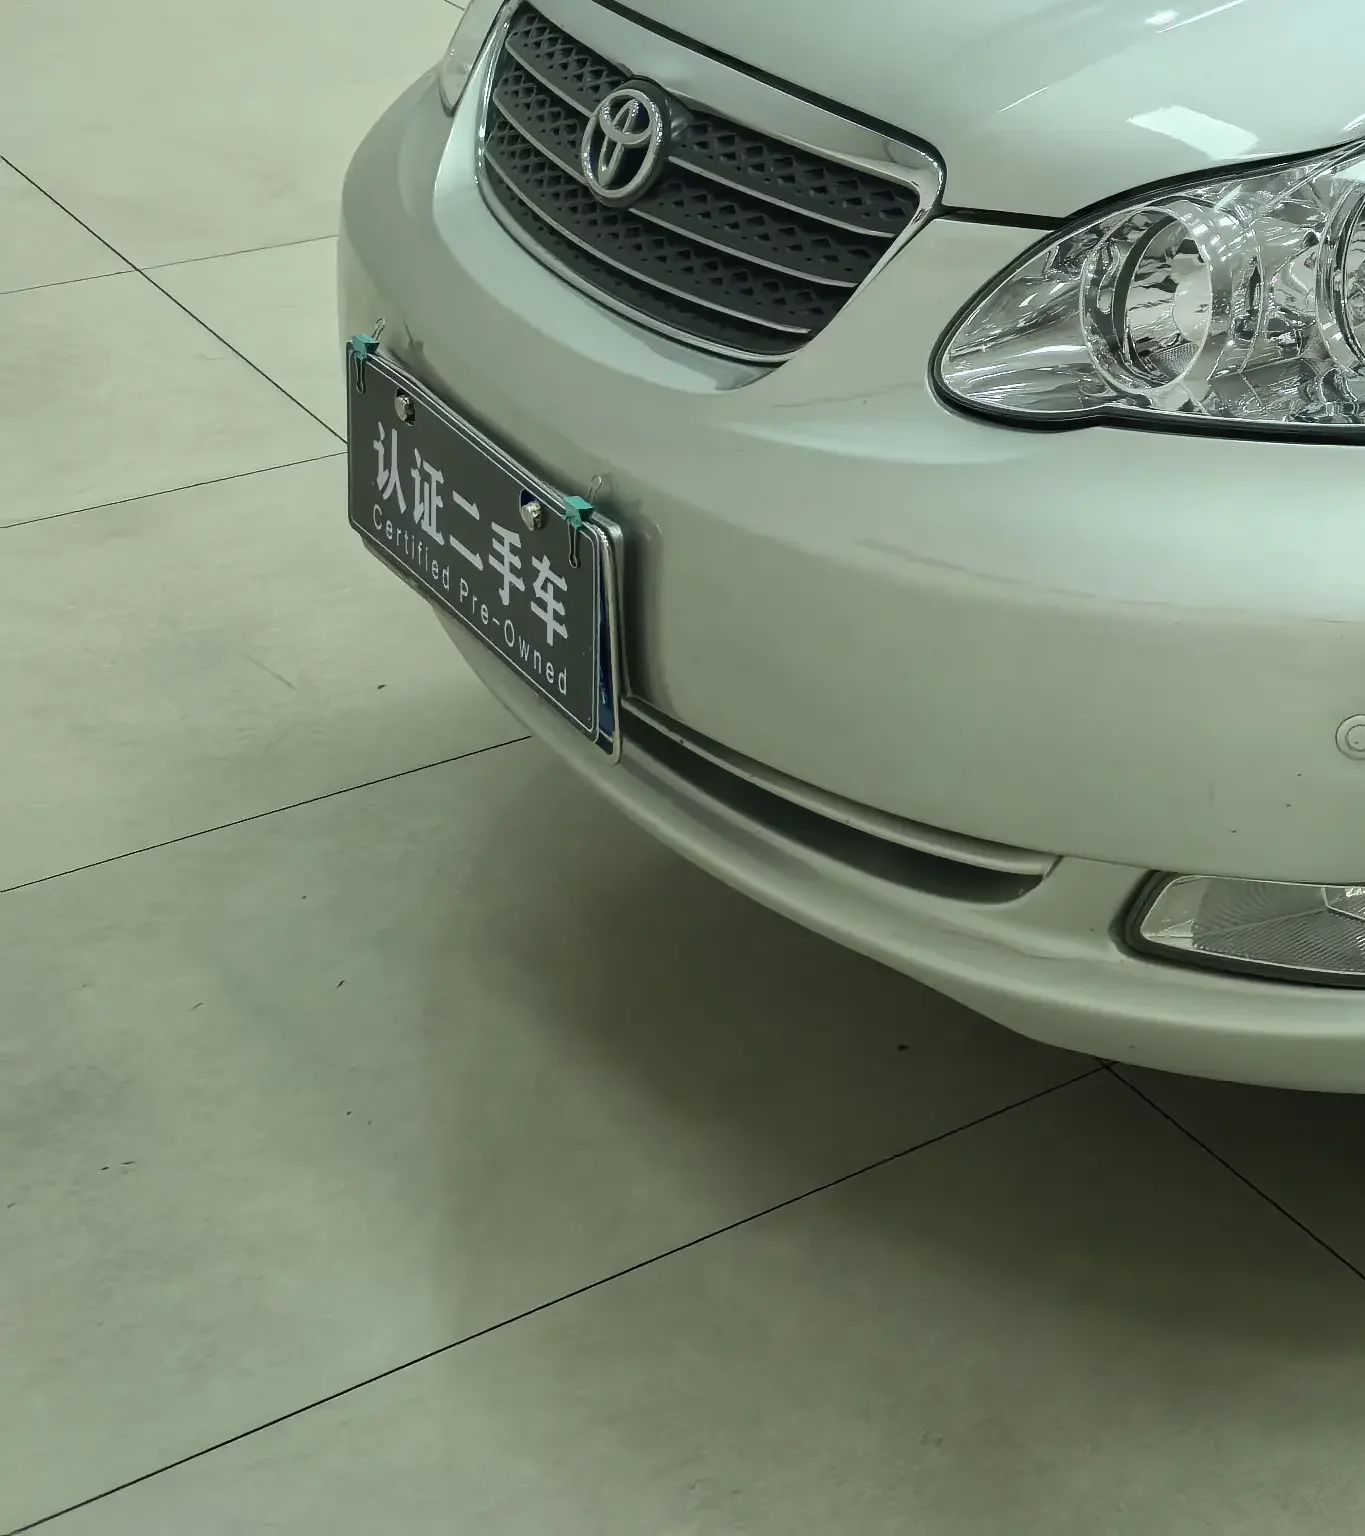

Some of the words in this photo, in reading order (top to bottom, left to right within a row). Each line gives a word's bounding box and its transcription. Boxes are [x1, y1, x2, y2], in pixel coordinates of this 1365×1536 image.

[371, 504, 451, 591] Certified
[458, 579, 568, 696] Pre-Owned
[372, 421, 569, 646] 认证二手车
